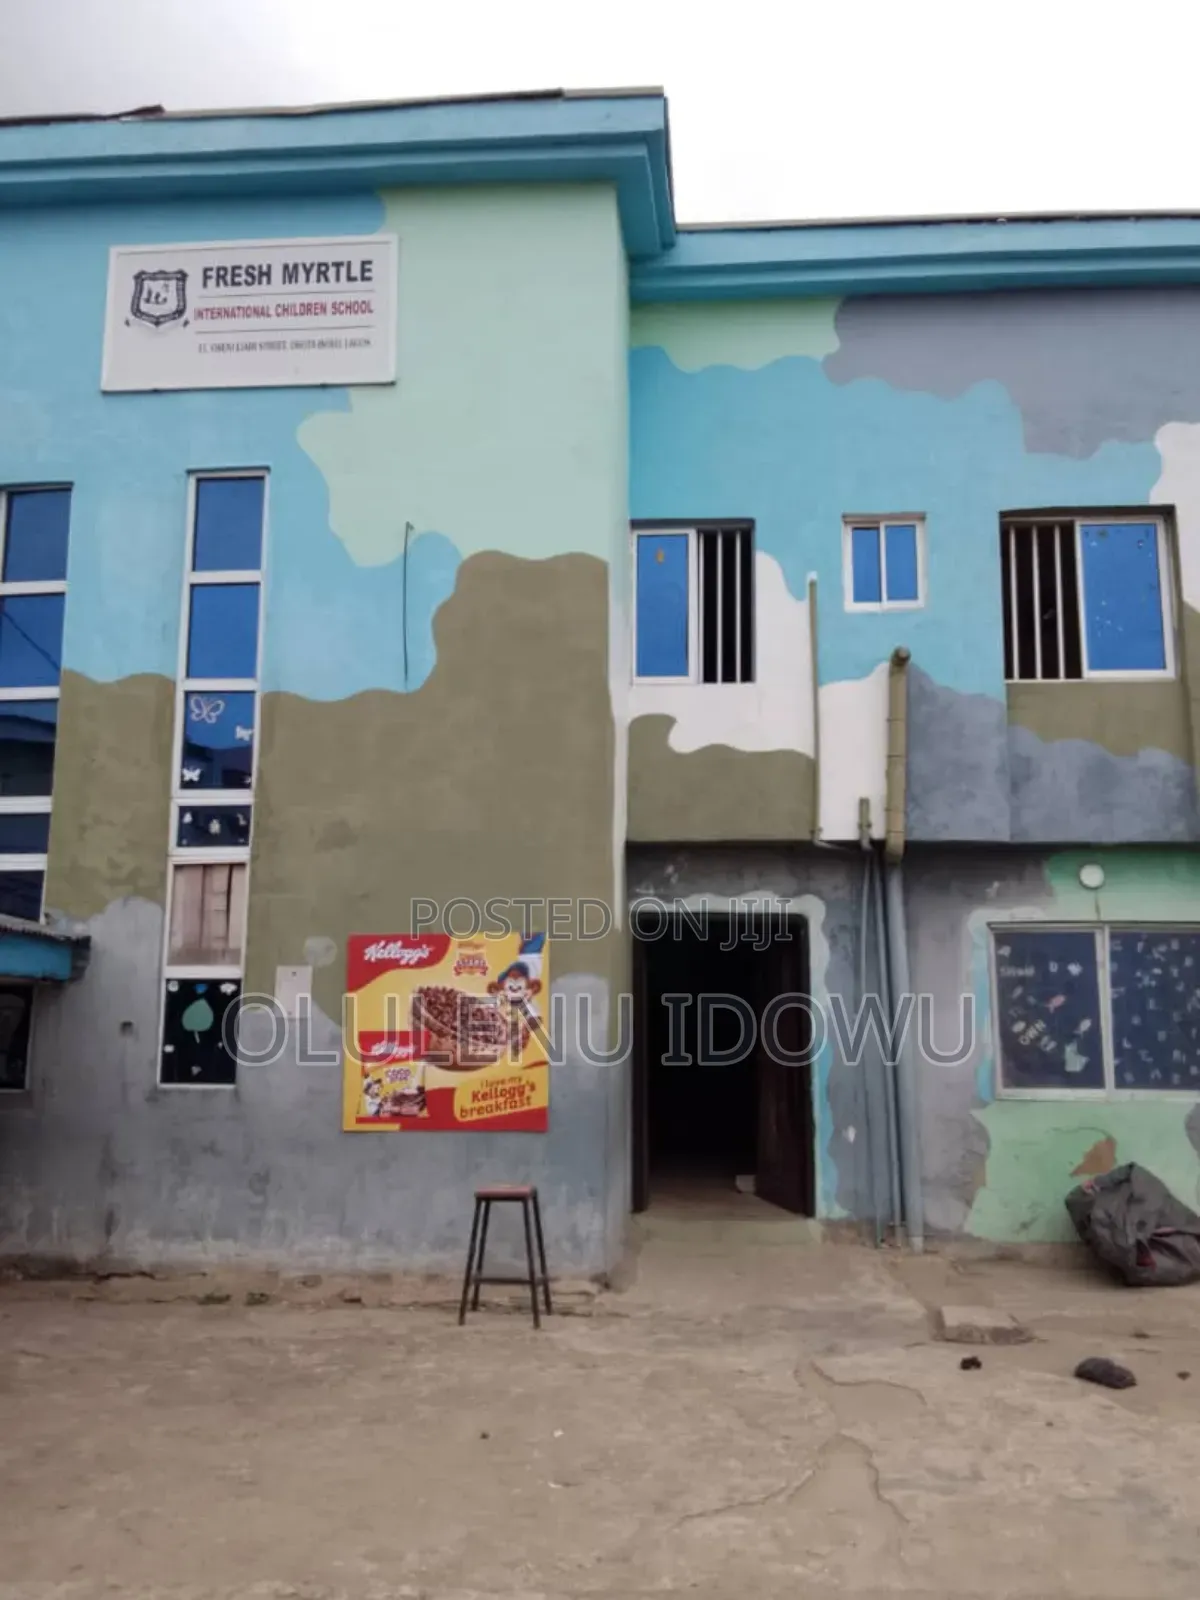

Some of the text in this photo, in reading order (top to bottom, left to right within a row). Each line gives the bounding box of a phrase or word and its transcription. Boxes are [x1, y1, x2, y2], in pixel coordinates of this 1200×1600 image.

[202, 260, 373, 289] FRESH MYRTLE
[194, 300, 374, 321] INTERNATIONAL CHILDREN SCHOOL
[364, 940, 433, 965] Kellogg's
[472, 1081, 536, 1103] Kellogg's
[460, 1095, 532, 1119] breakfast
